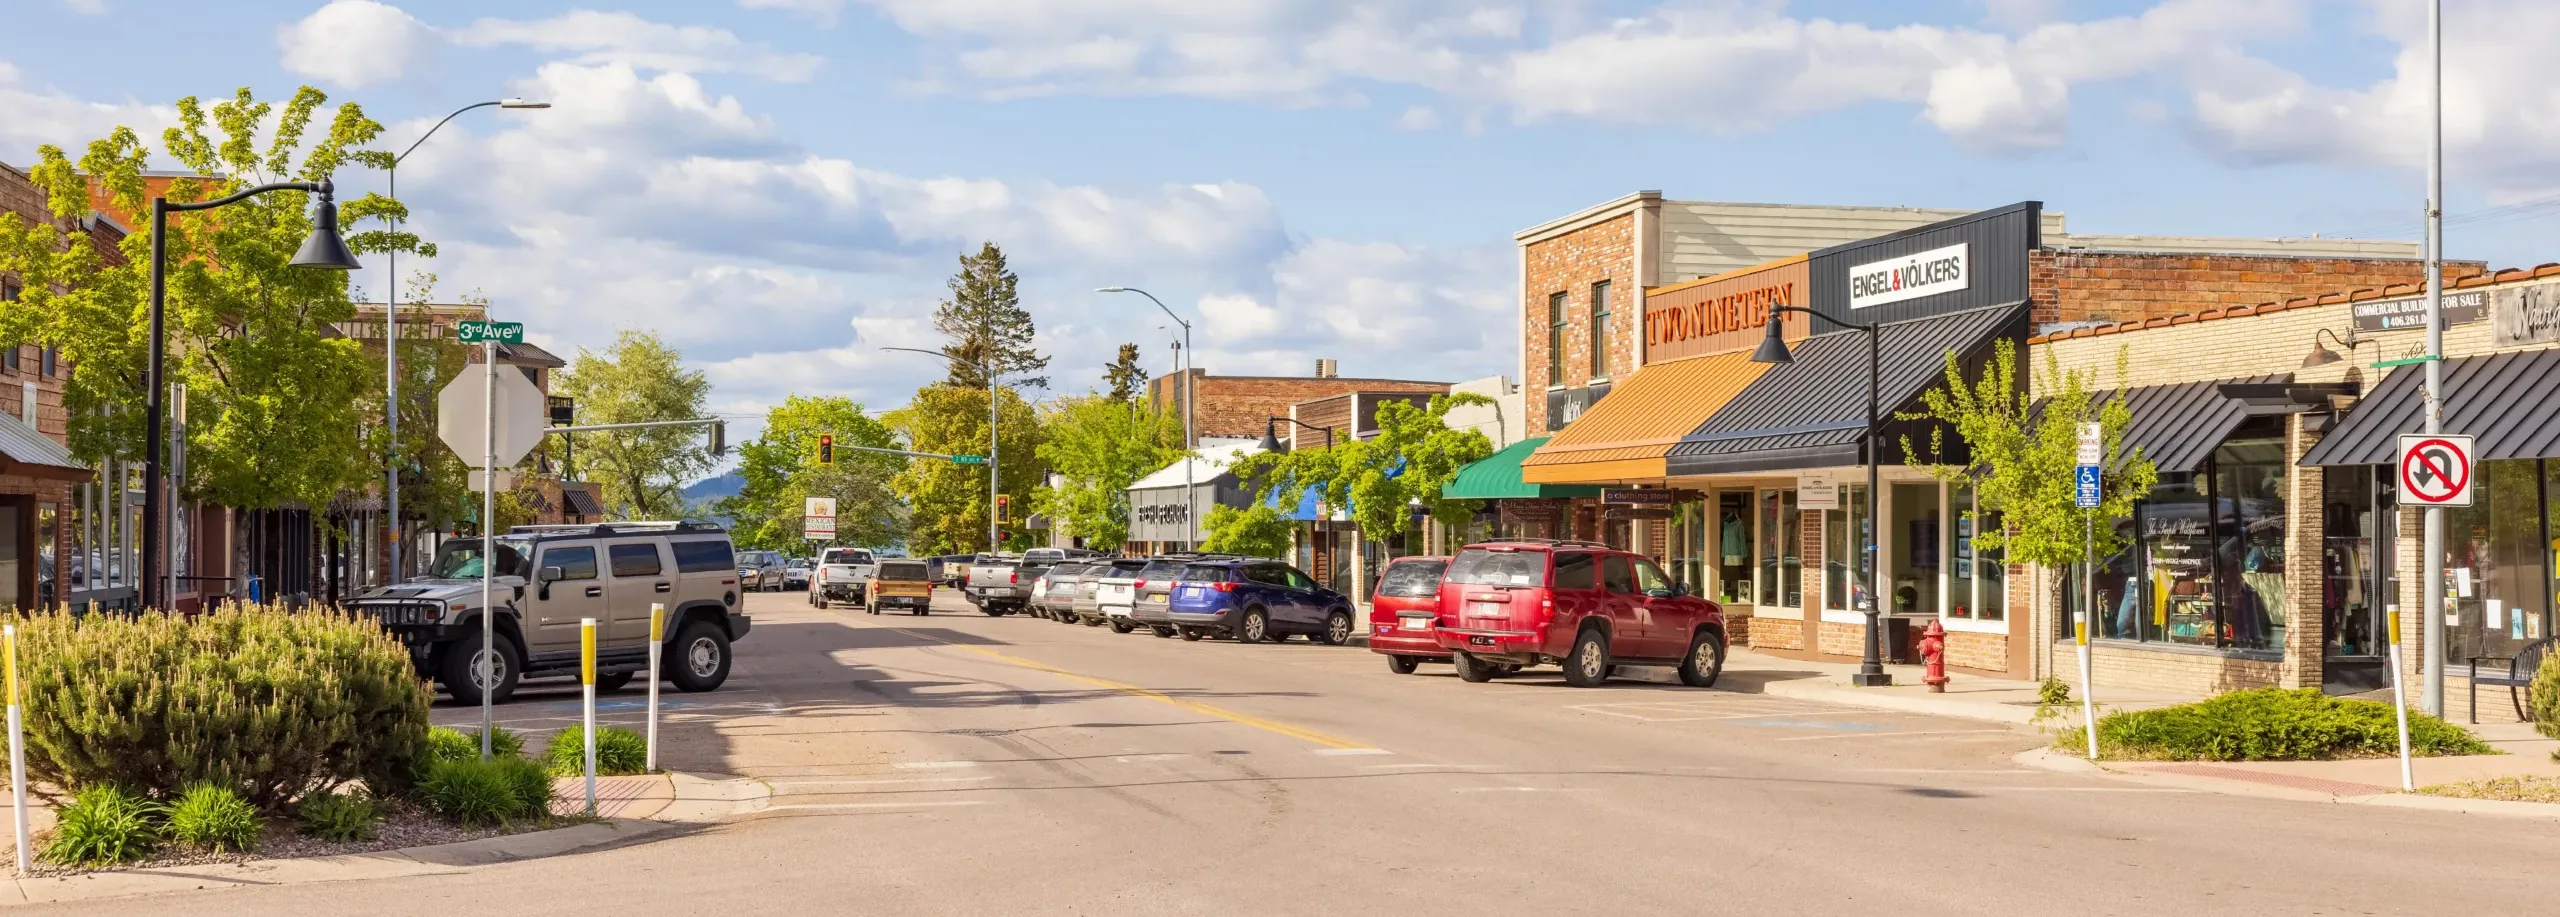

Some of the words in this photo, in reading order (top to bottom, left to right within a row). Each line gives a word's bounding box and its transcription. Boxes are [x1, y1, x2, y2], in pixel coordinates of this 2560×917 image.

[2354, 302, 2401, 317] COMMERCIAL
[2441, 296, 2459, 309] FOR
[2460, 293, 2482, 307] SALE
[1646, 307, 1688, 346] TWO
[2390, 314, 2427, 327] 406.261.0
[460, 323, 483, 339] 3rd
[1614, 491, 1648, 501] clothing
[1650, 492, 1670, 500] store
[2145, 517, 2157, 535] The
